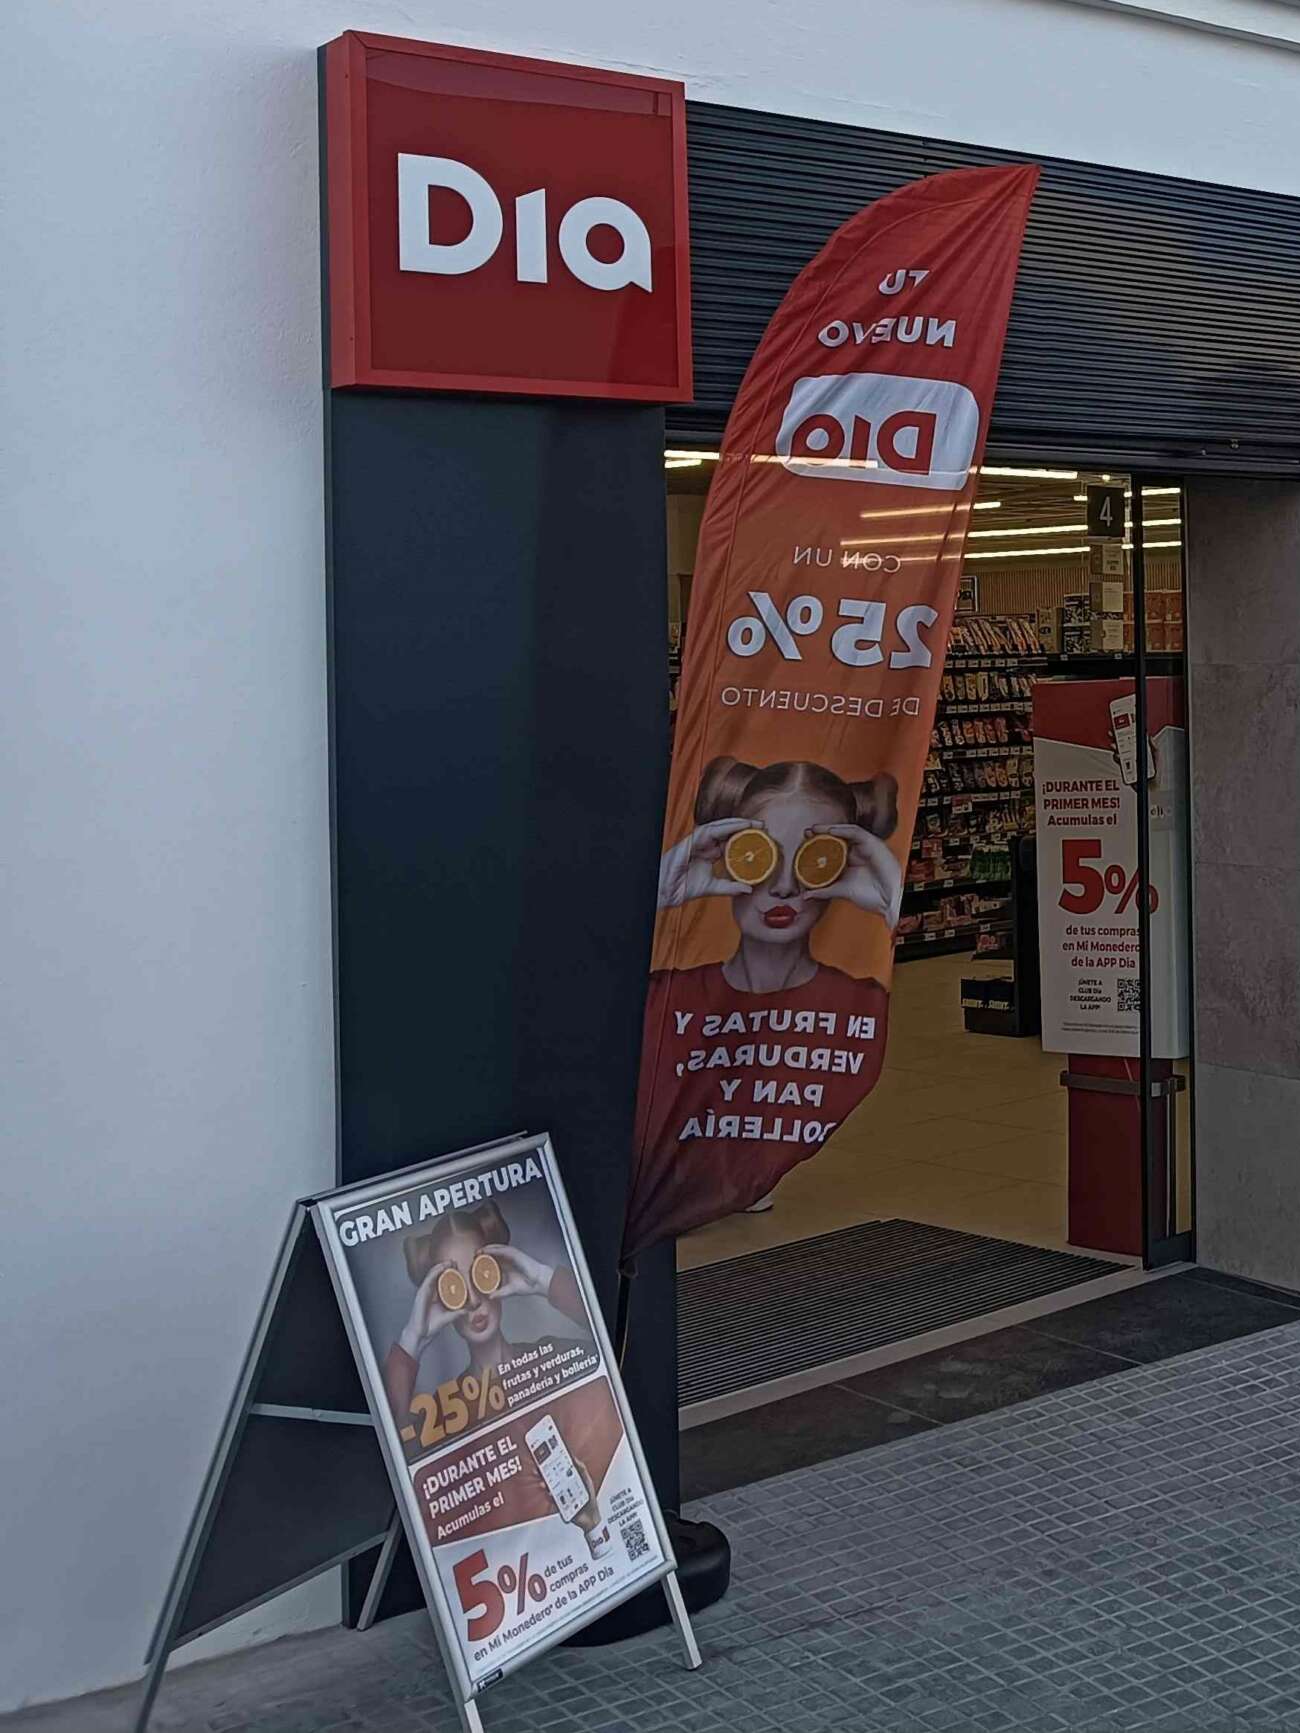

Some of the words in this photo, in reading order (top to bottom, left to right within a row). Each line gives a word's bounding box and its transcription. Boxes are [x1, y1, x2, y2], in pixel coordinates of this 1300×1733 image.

[1100, 496, 1113, 527] 4
[1042, 780, 1104, 794] ¡DURANTE
[1105, 780, 1120, 791] EL
[1043, 798, 1089, 810] PRIMER
[1092, 797, 1120, 809] MES!
[1047, 814, 1104, 826] Acumulas
[1107, 814, 1117, 825] el
[1058, 839, 1159, 914] 5%
[1063, 942, 1074, 951] en
[1076, 941, 1088, 951] Mi
[1066, 925, 1078, 935] de
[1081, 926, 1096, 936] tus
[1098, 927, 1140, 938] compras
[1072, 956, 1083, 967] de
[1086, 956, 1094, 967] la
[1096, 958, 1117, 968] APP
[339, 1201, 413, 1247] GRAN
[419, 1157, 543, 1221] APERTURA
[497, 1363, 511, 1375] En
[511, 1350, 538, 1368] todas
[539, 1343, 553, 1356] las
[502, 1370, 531, 1390] frutas
[532, 1366, 539, 1378] y
[540, 1346, 584, 1371] verduras,
[507, 1376, 553, 1407] panadería
[553, 1372, 561, 1384] y
[400, 1367, 504, 1447] -25%
[423, 1445, 496, 1499] ¡DURANTE
[497, 1435, 517, 1456] EL
[429, 1476, 486, 1519] PRIMER
[486, 1455, 523, 1487] MES!
[437, 1504, 491, 1540] Acumulas
[493, 1491, 505, 1508] el
[544, 1562, 557, 1578] de
[557, 1554, 573, 1571] tus
[550, 1563, 589, 1593] compras
[453, 1548, 547, 1642] 5%
[474, 1648, 488, 1661] en
[488, 1636, 502, 1654] Mi
[554, 1596, 568, 1610] de
[568, 1589, 577, 1601] la
[578, 1575, 597, 1595] APP
